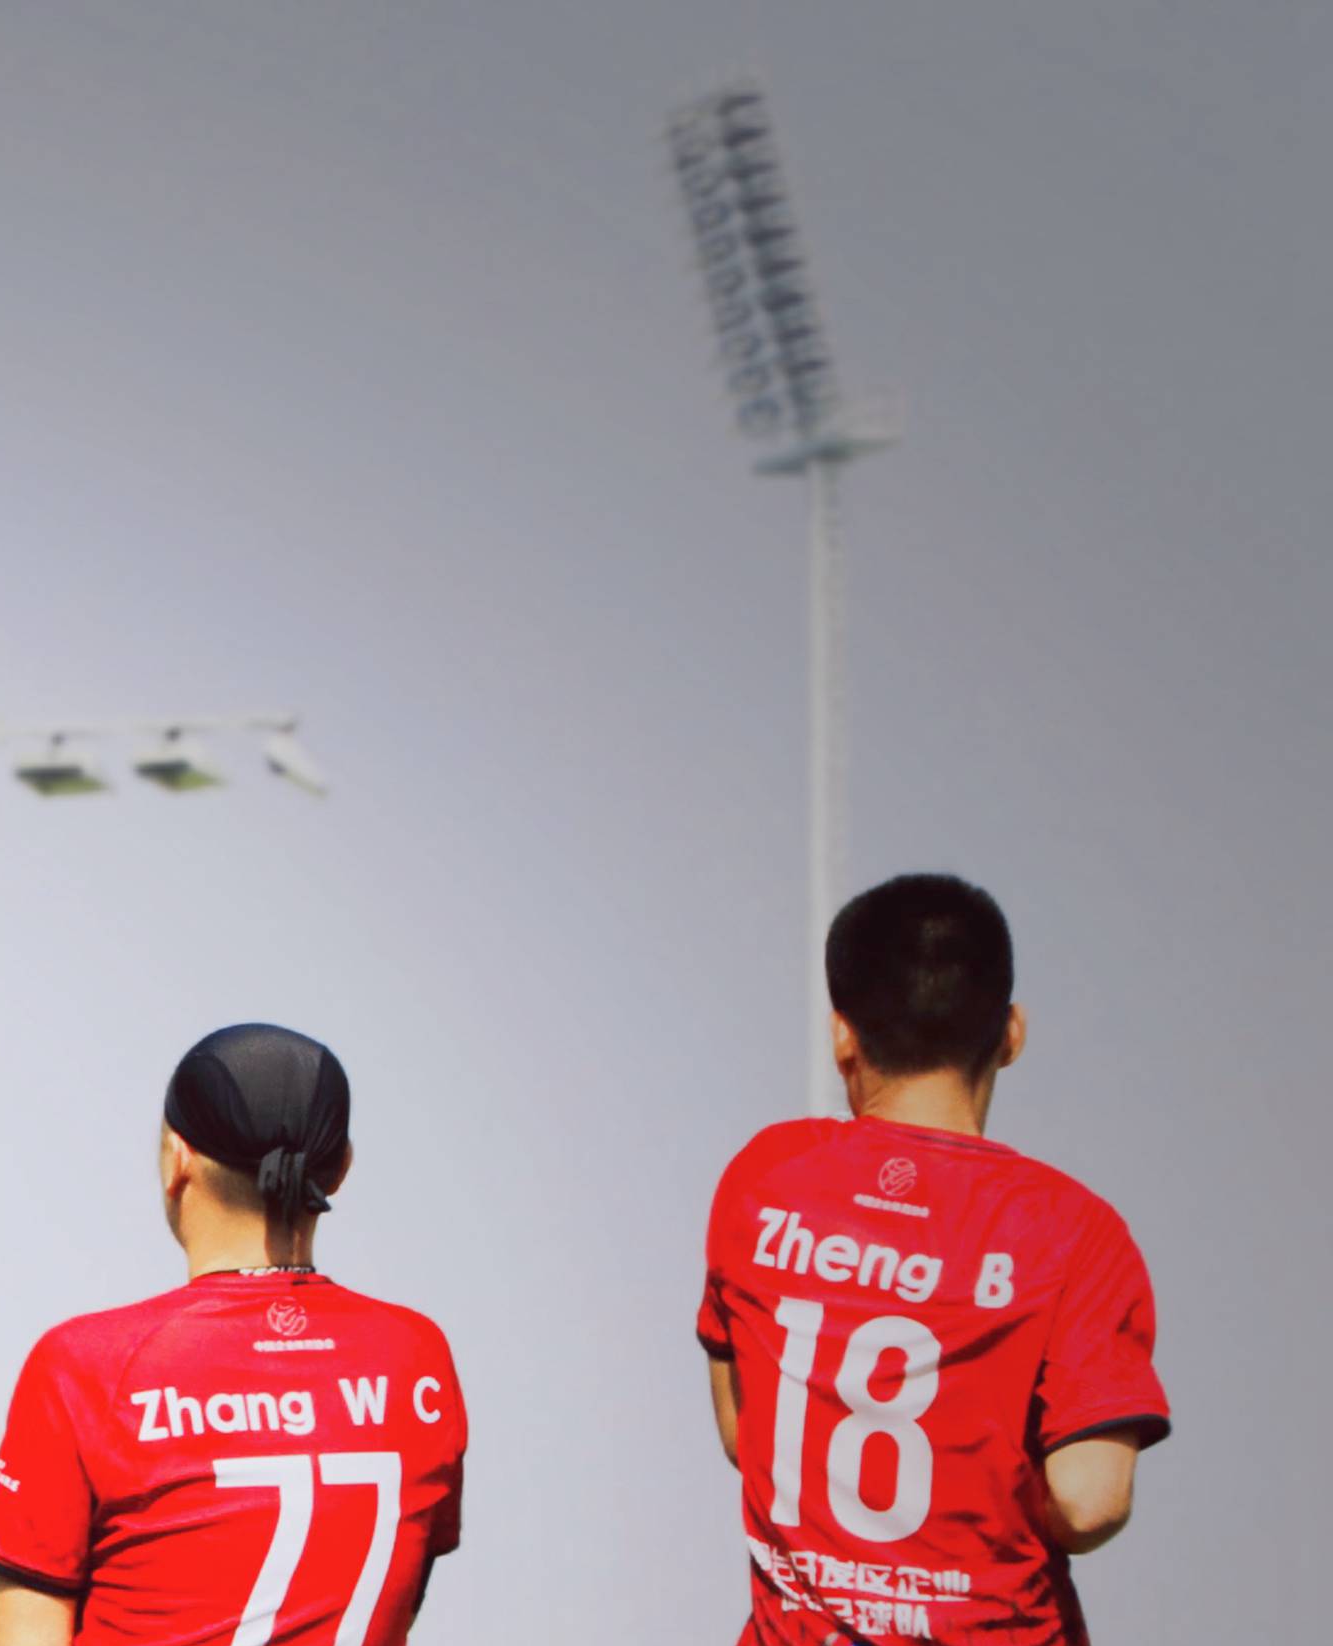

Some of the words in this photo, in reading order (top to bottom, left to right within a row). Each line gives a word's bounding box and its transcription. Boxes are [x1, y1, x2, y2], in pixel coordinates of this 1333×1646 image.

[753, 1207, 943, 1303] Zheng
[974, 1253, 1014, 1309] B
[131, 1386, 316, 1441] Zhang
[338, 1375, 389, 1426] W
[413, 1376, 441, 1424] C
[770, 1296, 942, 1542] 18
